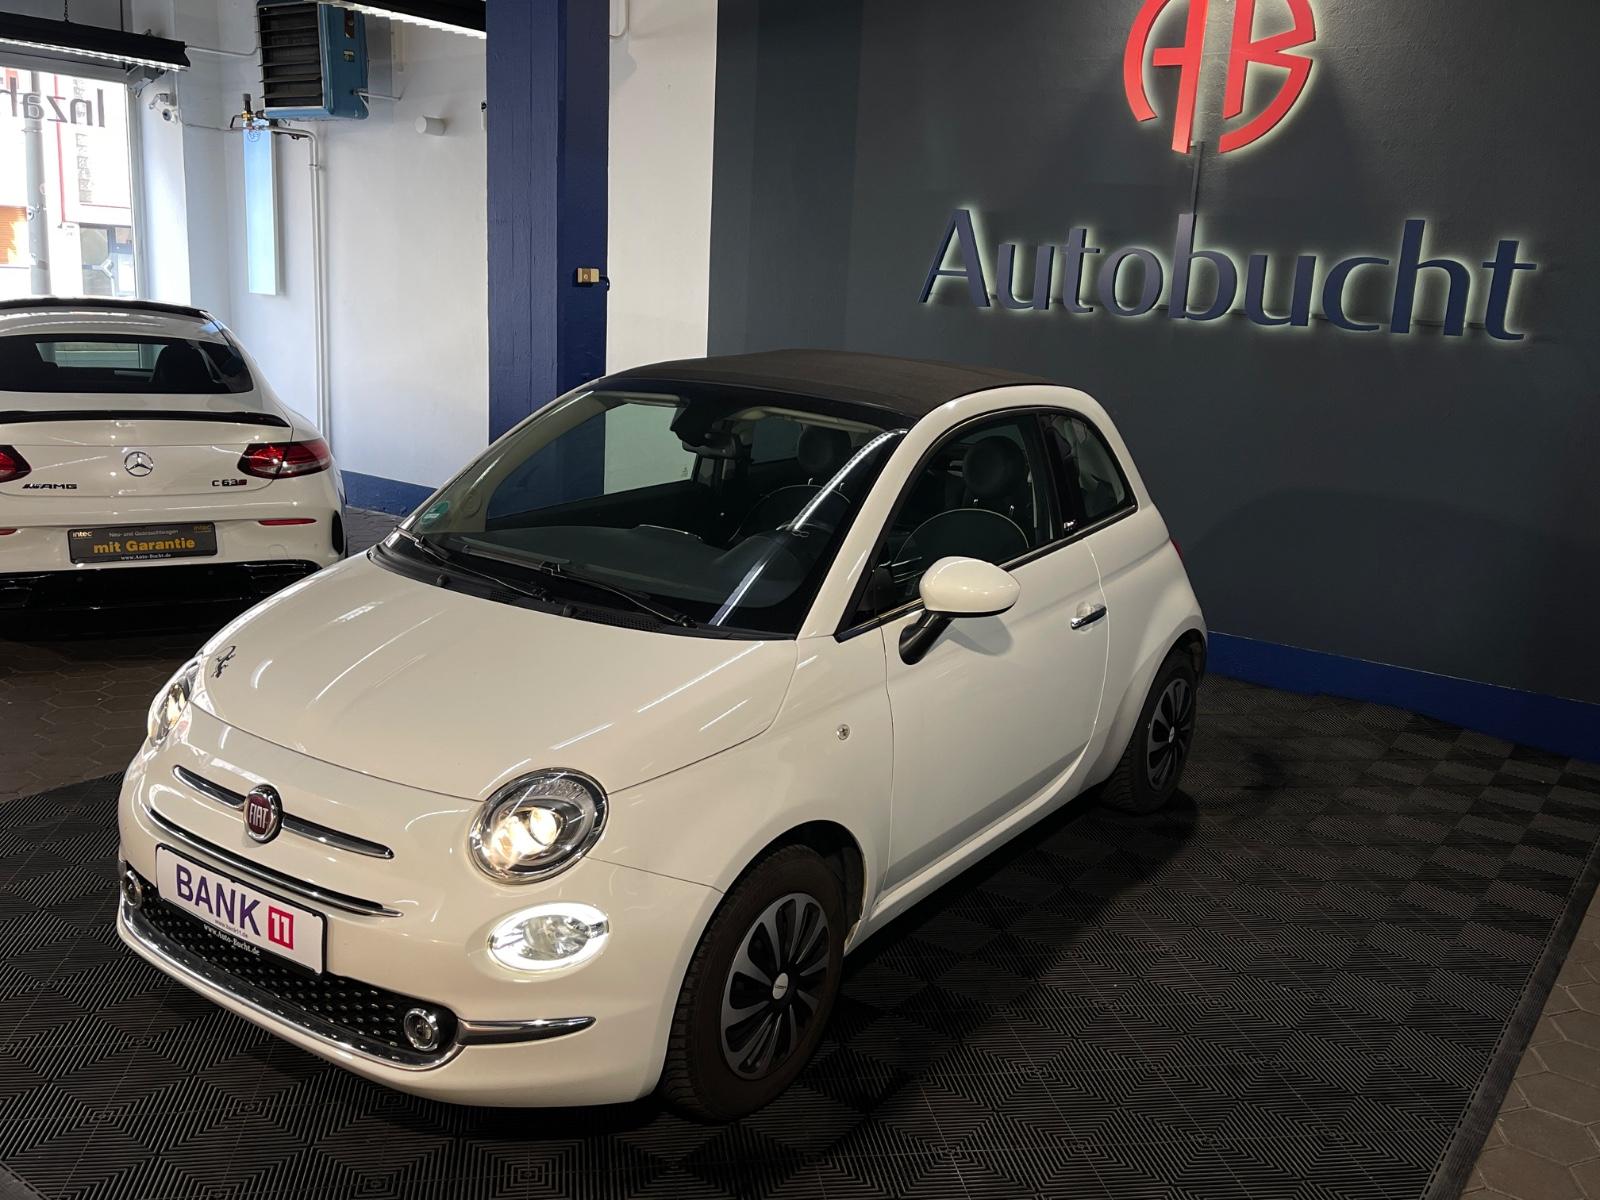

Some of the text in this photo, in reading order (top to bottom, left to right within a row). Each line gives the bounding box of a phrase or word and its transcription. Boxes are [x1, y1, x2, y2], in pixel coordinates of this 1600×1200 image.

[917, 208, 1538, 341] Autobucht
[72, 530, 93, 538] intec
[93, 537, 196, 554] mit Garantie
[250, 803, 269, 829] FIAT
[176, 863, 290, 945] BANK 11
